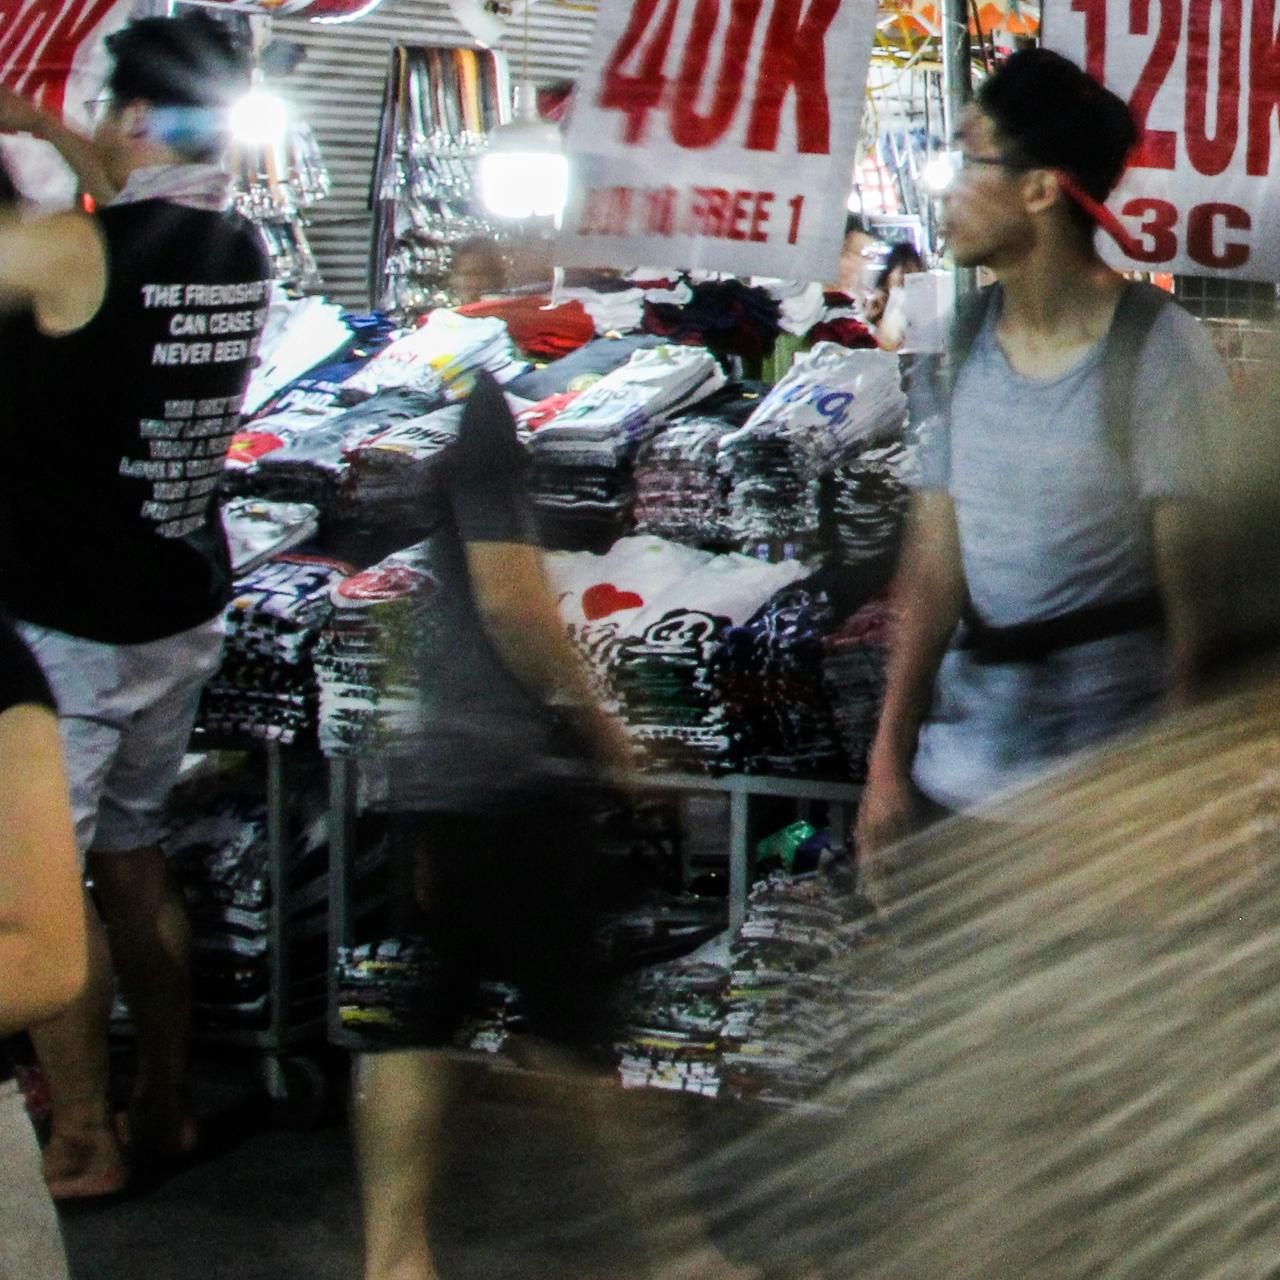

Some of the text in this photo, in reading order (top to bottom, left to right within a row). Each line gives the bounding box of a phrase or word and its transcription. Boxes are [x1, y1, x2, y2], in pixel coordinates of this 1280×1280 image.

[693, 186, 775, 243] FREE
[787, 195, 805, 246] 1
[1115, 197, 1251, 269] 3C
[141, 283, 182, 308] THE
[169, 313, 207, 336] CAN
[152, 341, 213, 366] NEVER
